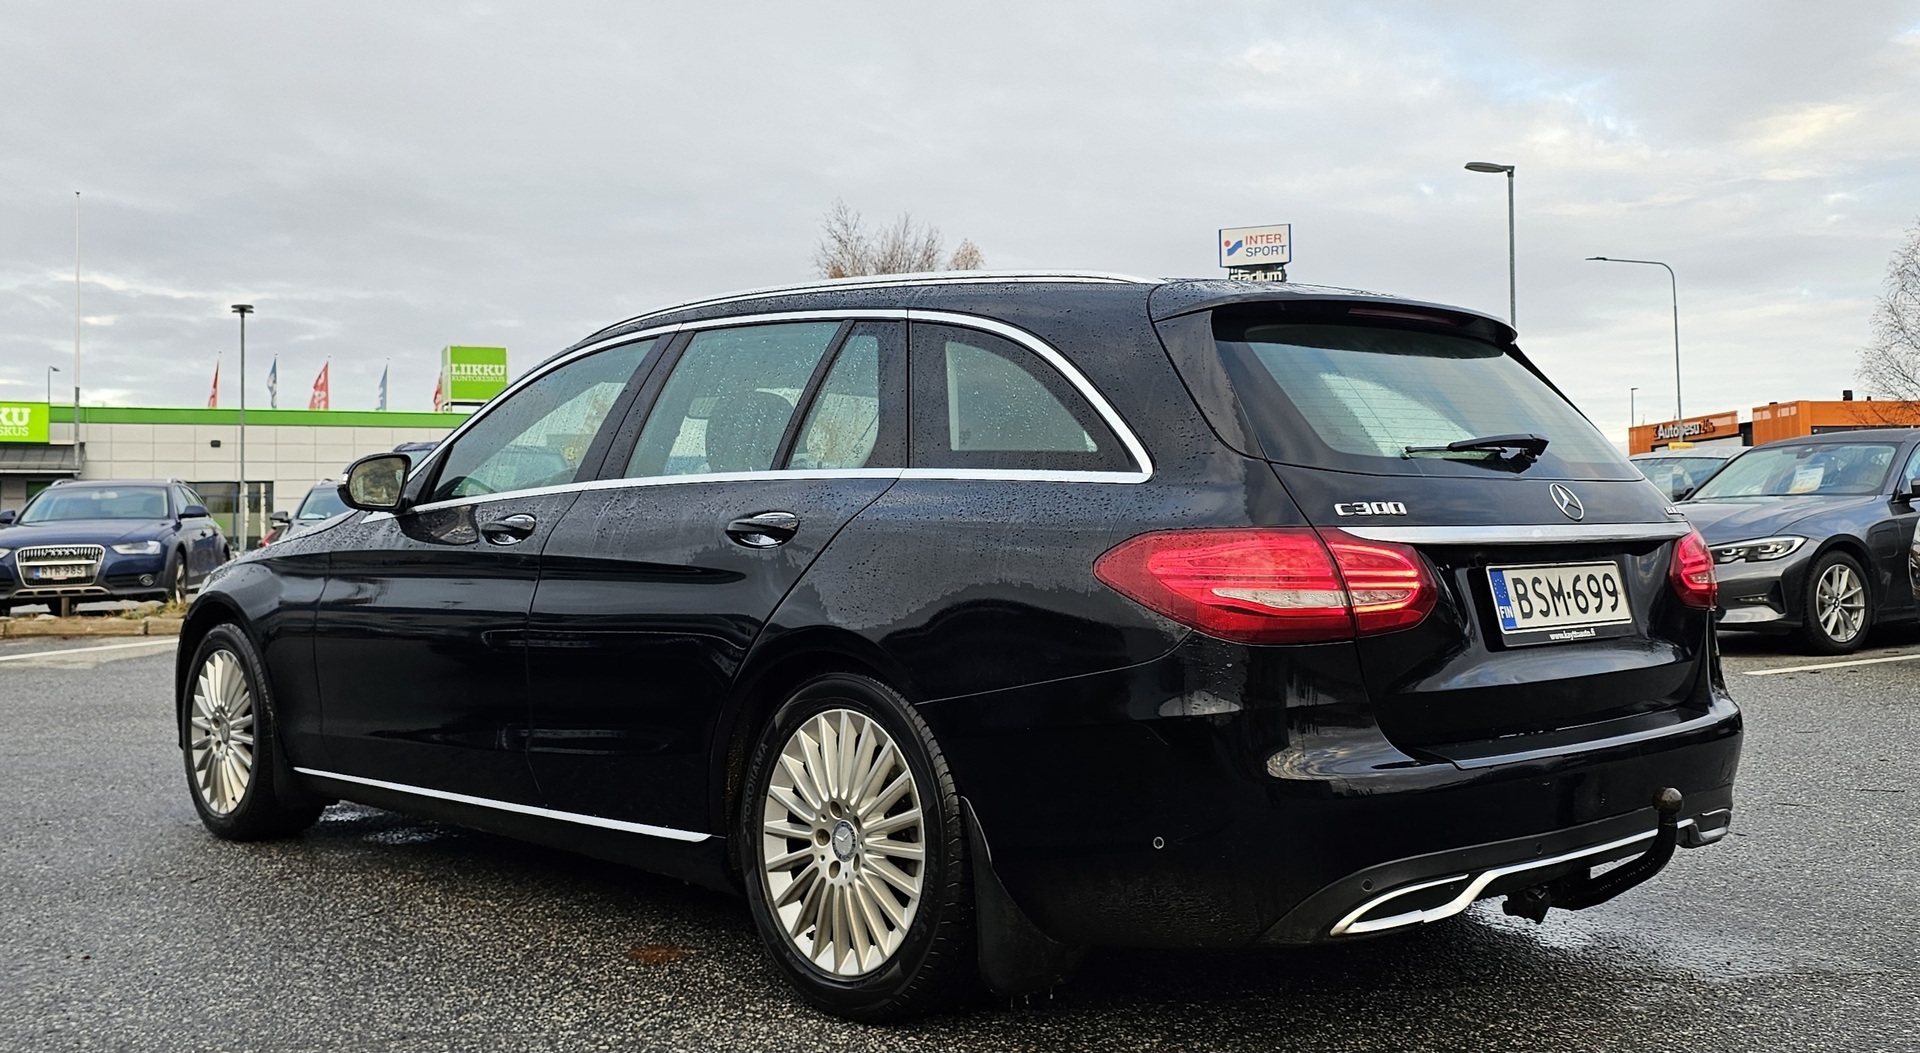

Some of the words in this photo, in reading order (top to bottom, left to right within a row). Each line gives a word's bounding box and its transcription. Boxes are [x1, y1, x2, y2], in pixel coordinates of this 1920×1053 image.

[1245, 233, 1282, 245] INTER
[1245, 245, 1287, 257] SPORT
[451, 364, 506, 376] LIIKKU
[1334, 501, 1408, 516] C300
[1511, 573, 1619, 620] BSM-699
[1500, 605, 1514, 619] FIN
[742, 742, 769, 823] YOKOHAMA
